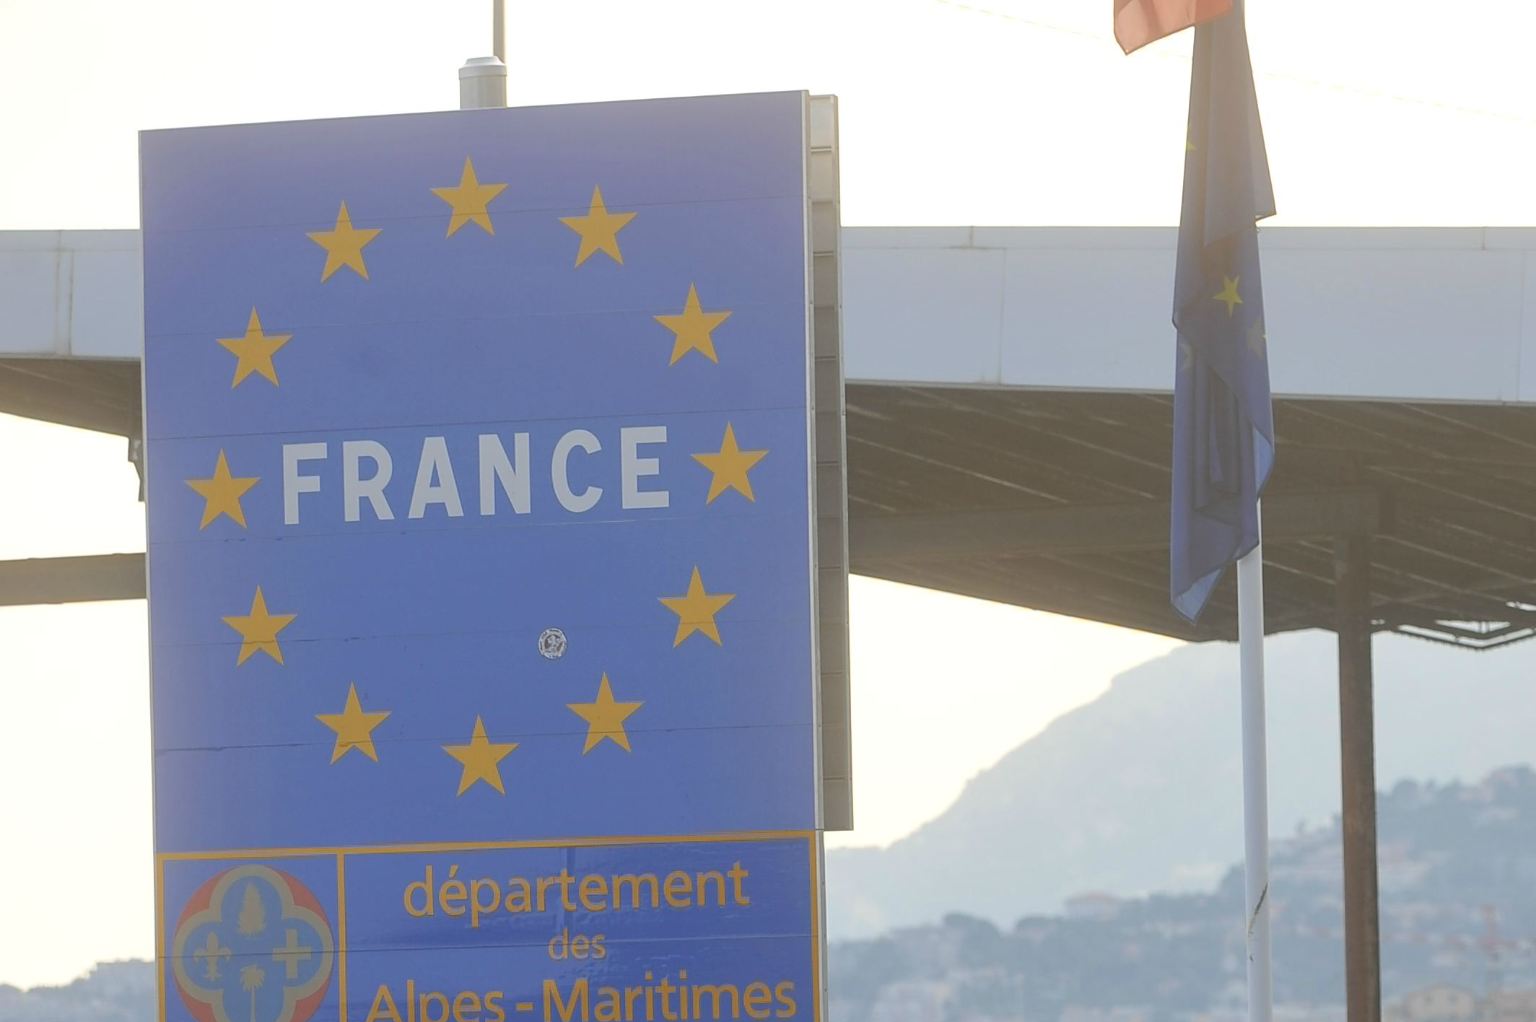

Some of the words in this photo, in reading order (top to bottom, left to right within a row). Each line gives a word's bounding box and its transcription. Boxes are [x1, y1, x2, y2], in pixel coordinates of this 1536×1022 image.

[282, 425, 670, 525] FRANCE
[403, 861, 750, 929] département
[548, 928, 607, 961] des
